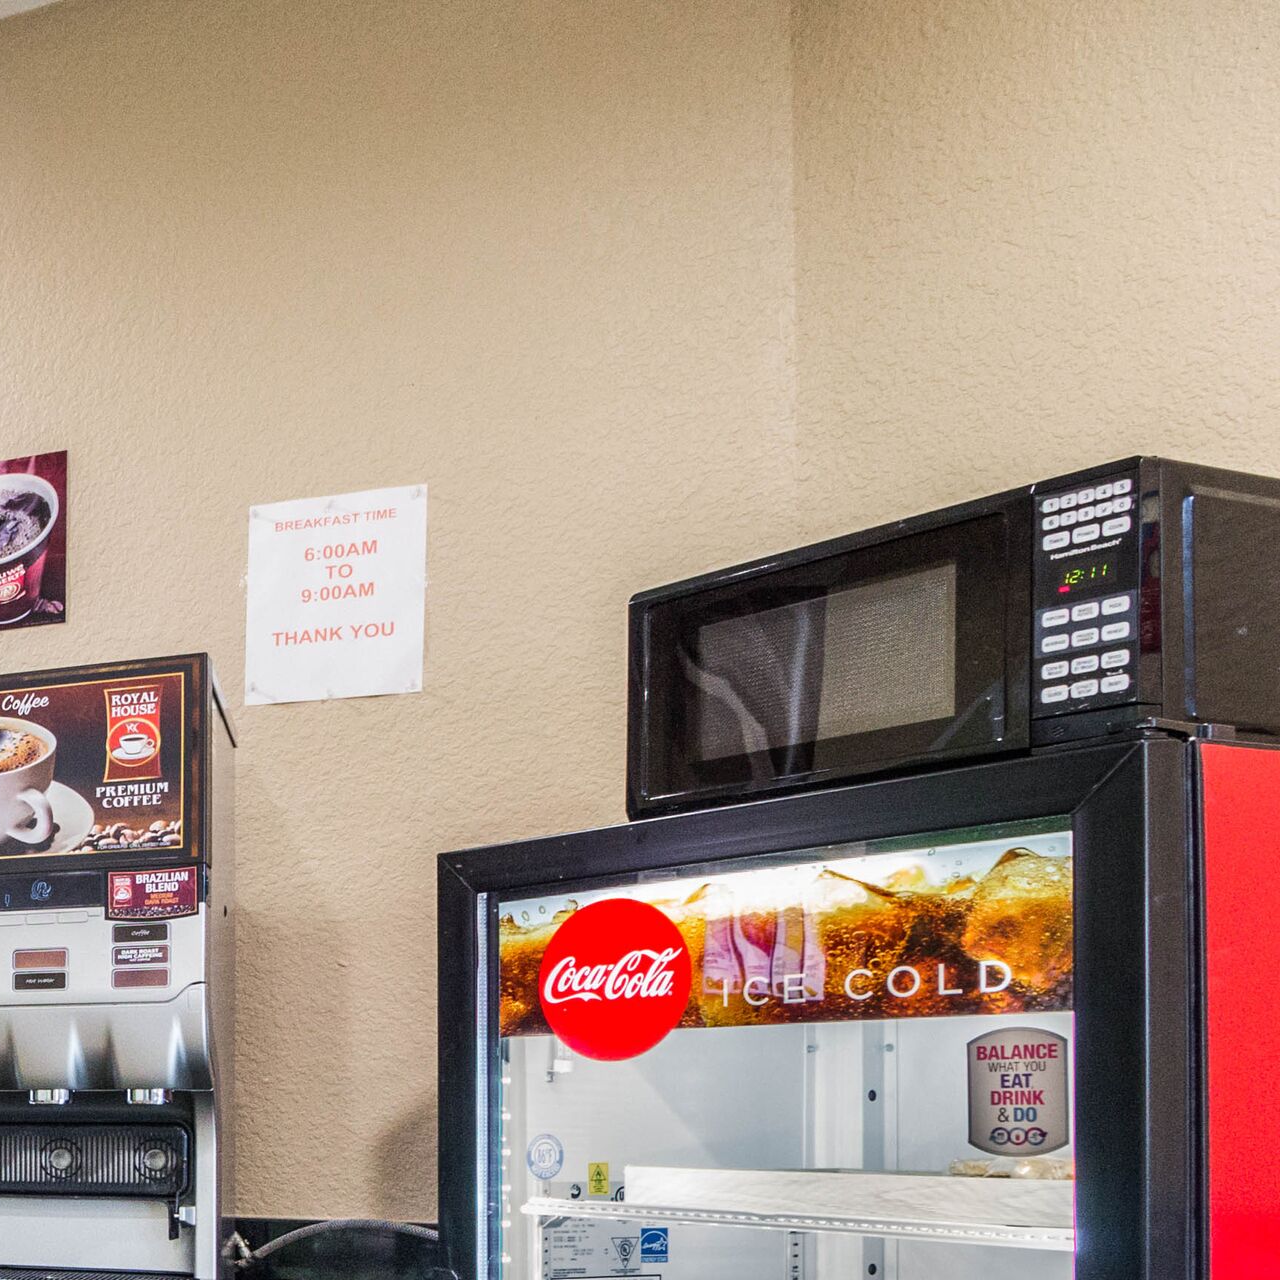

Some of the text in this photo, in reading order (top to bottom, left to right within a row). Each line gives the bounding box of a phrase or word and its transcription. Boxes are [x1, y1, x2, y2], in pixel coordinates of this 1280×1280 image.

[274, 508, 397, 533] BREAKFAST TIME
[304, 539, 378, 562] 6:00AM
[325, 563, 353, 580] TO
[1064, 563, 1108, 584] 12:11
[301, 582, 375, 604] 9:00AM
[272, 621, 395, 647] THANK YOU
[1, 693, 50, 716] Coffee
[111, 692, 158, 706] ROYAL
[111, 703, 156, 718] HOUSE
[96, 781, 169, 798] PREMIUM
[102, 794, 162, 809] COFFEE
[135, 871, 189, 884] BRAZILIAN
[145, 882, 179, 893] BLEND
[543, 945, 683, 1004] Coca-Cola
[721, 972, 807, 1008] ICE
[843, 959, 1012, 1002] COLD
[976, 1043, 1059, 1061] BALANCE
[988, 1060, 1047, 1073] WHAT YOU
[990, 1090, 1045, 1106] DRINK
[997, 1107, 1038, 1123] & DO
